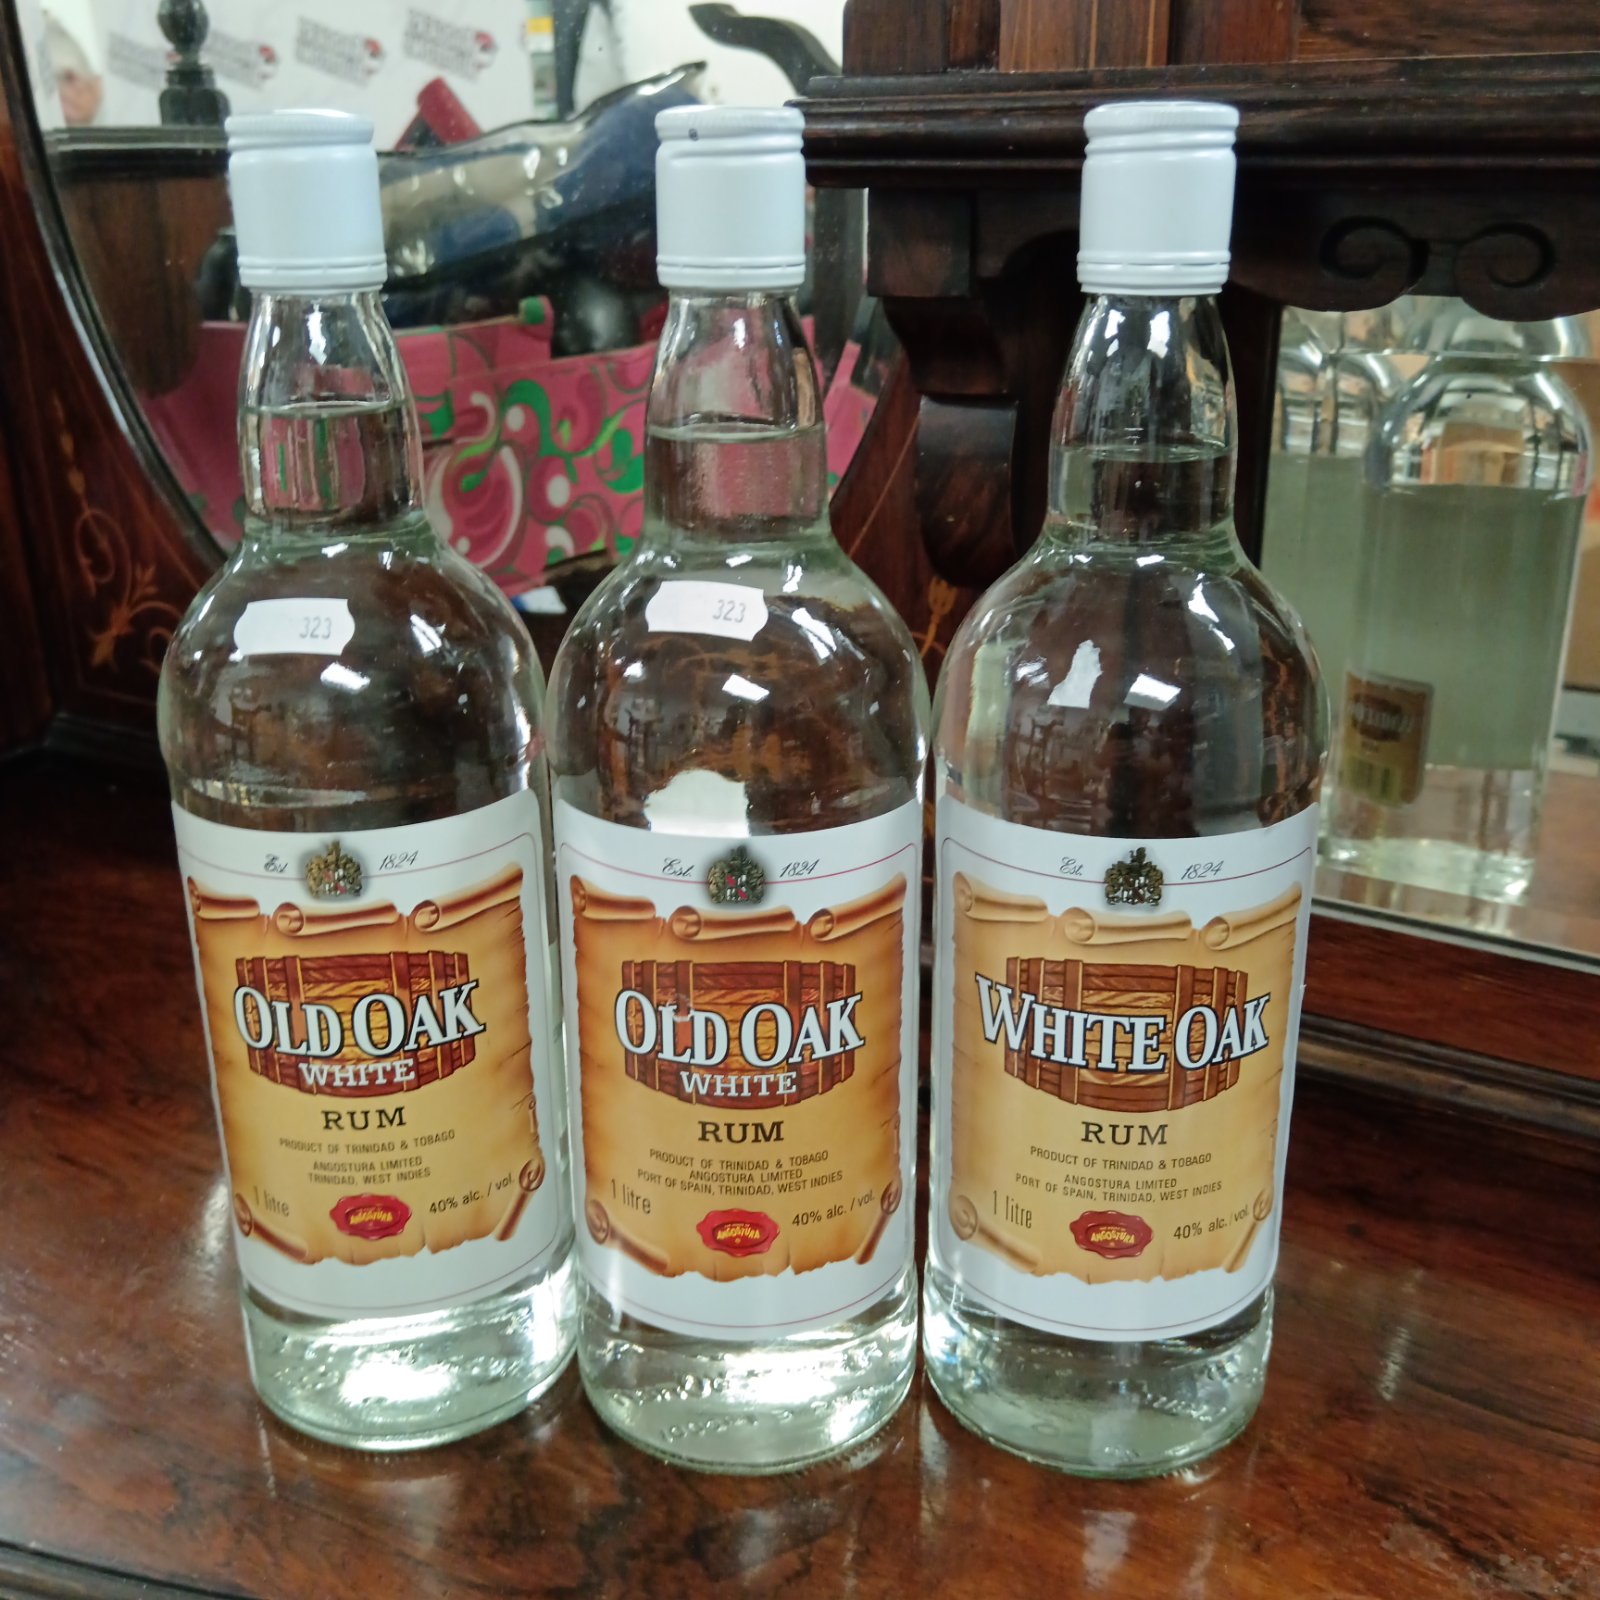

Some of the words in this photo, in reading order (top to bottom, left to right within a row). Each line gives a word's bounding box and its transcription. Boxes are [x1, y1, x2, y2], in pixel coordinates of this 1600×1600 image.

[712, 599, 746, 623] 323
[299, 616, 332, 640] 323
[379, 850, 419, 871] 1824
[1181, 861, 1224, 880] 1824
[233, 986, 343, 1058] OLD
[352, 979, 486, 1058] OAK
[614, 989, 729, 1066] OLD
[740, 992, 865, 1068] OAK
[975, 971, 1169, 1074] WHITE
[1174, 992, 1271, 1071] OAK
[298, 1058, 416, 1087] WHITE
[679, 1071, 797, 1098] WHITE
[321, 1106, 407, 1130] RUM
[279, 1137, 323, 1153] PRODUCT
[327, 1143, 340, 1154] OF
[345, 1141, 395, 1154] TRINIDAD
[400, 1139, 409, 1150] &
[413, 1129, 456, 1148] TOBAGO
[697, 1121, 785, 1143] RUM
[1081, 1121, 1168, 1146] RUM
[313, 1159, 376, 1173] ANGOSTURA
[380, 1156, 423, 1170] LIMITED
[650, 1148, 694, 1167] PRODUCT
[700, 1158, 713, 1169] OF
[720, 1158, 769, 1171] TRINIDAD
[775, 1158, 783, 1168] &
[789, 1150, 829, 1166] TOBAGO
[1030, 1145, 1078, 1166] PRODUCT
[1083, 1157, 1098, 1169] OF
[1102, 1159, 1154, 1170] TRINIDAD
[1158, 1159, 1167, 1170] &
[1171, 1152, 1212, 1169] TOBAGO
[308, 1172, 359, 1186] TRINIDAD,
[362, 1172, 392, 1185] WEST
[396, 1166, 431, 1181] INDIES
[637, 1168, 662, 1184] PORT
[664, 1176, 677, 1188] OF
[679, 1180, 715, 1196] SPAIN,
[719, 1183, 773, 1196] TRINIDAD,
[777, 1179, 807, 1194] WEST
[809, 1170, 843, 1189] INDIES
[689, 1170, 755, 1183] ANGOSTURA
[761, 1167, 803, 1181] LIMITED
[1064, 1173, 1131, 1190] ANGOSTURA
[1135, 1178, 1177, 1190] LIMITED
[429, 1191, 459, 1215] 40%
[461, 1189, 483, 1205] alc.
[495, 1173, 515, 1191] vol.
[622, 1184, 652, 1214] litre
[1015, 1173, 1041, 1189] PORT
[1044, 1181, 1059, 1193] OF
[1062, 1185, 1097, 1202] SPAIN,
[1102, 1190, 1155, 1203] TRINIDAD,
[1159, 1188, 1189, 1202] WEST
[1192, 1180, 1223, 1196] INDIES
[263, 1190, 290, 1217] litre
[791, 1209, 822, 1227] 40%
[826, 1202, 847, 1221] alc.
[857, 1190, 875, 1208] vol.
[1005, 1196, 1033, 1229] litre
[1173, 1222, 1203, 1240] 40%
[1207, 1214, 1229, 1232] alc.
[1233, 1204, 1251, 1222] vol.
[1090, 1229, 1136, 1244] ANGOSTURA
